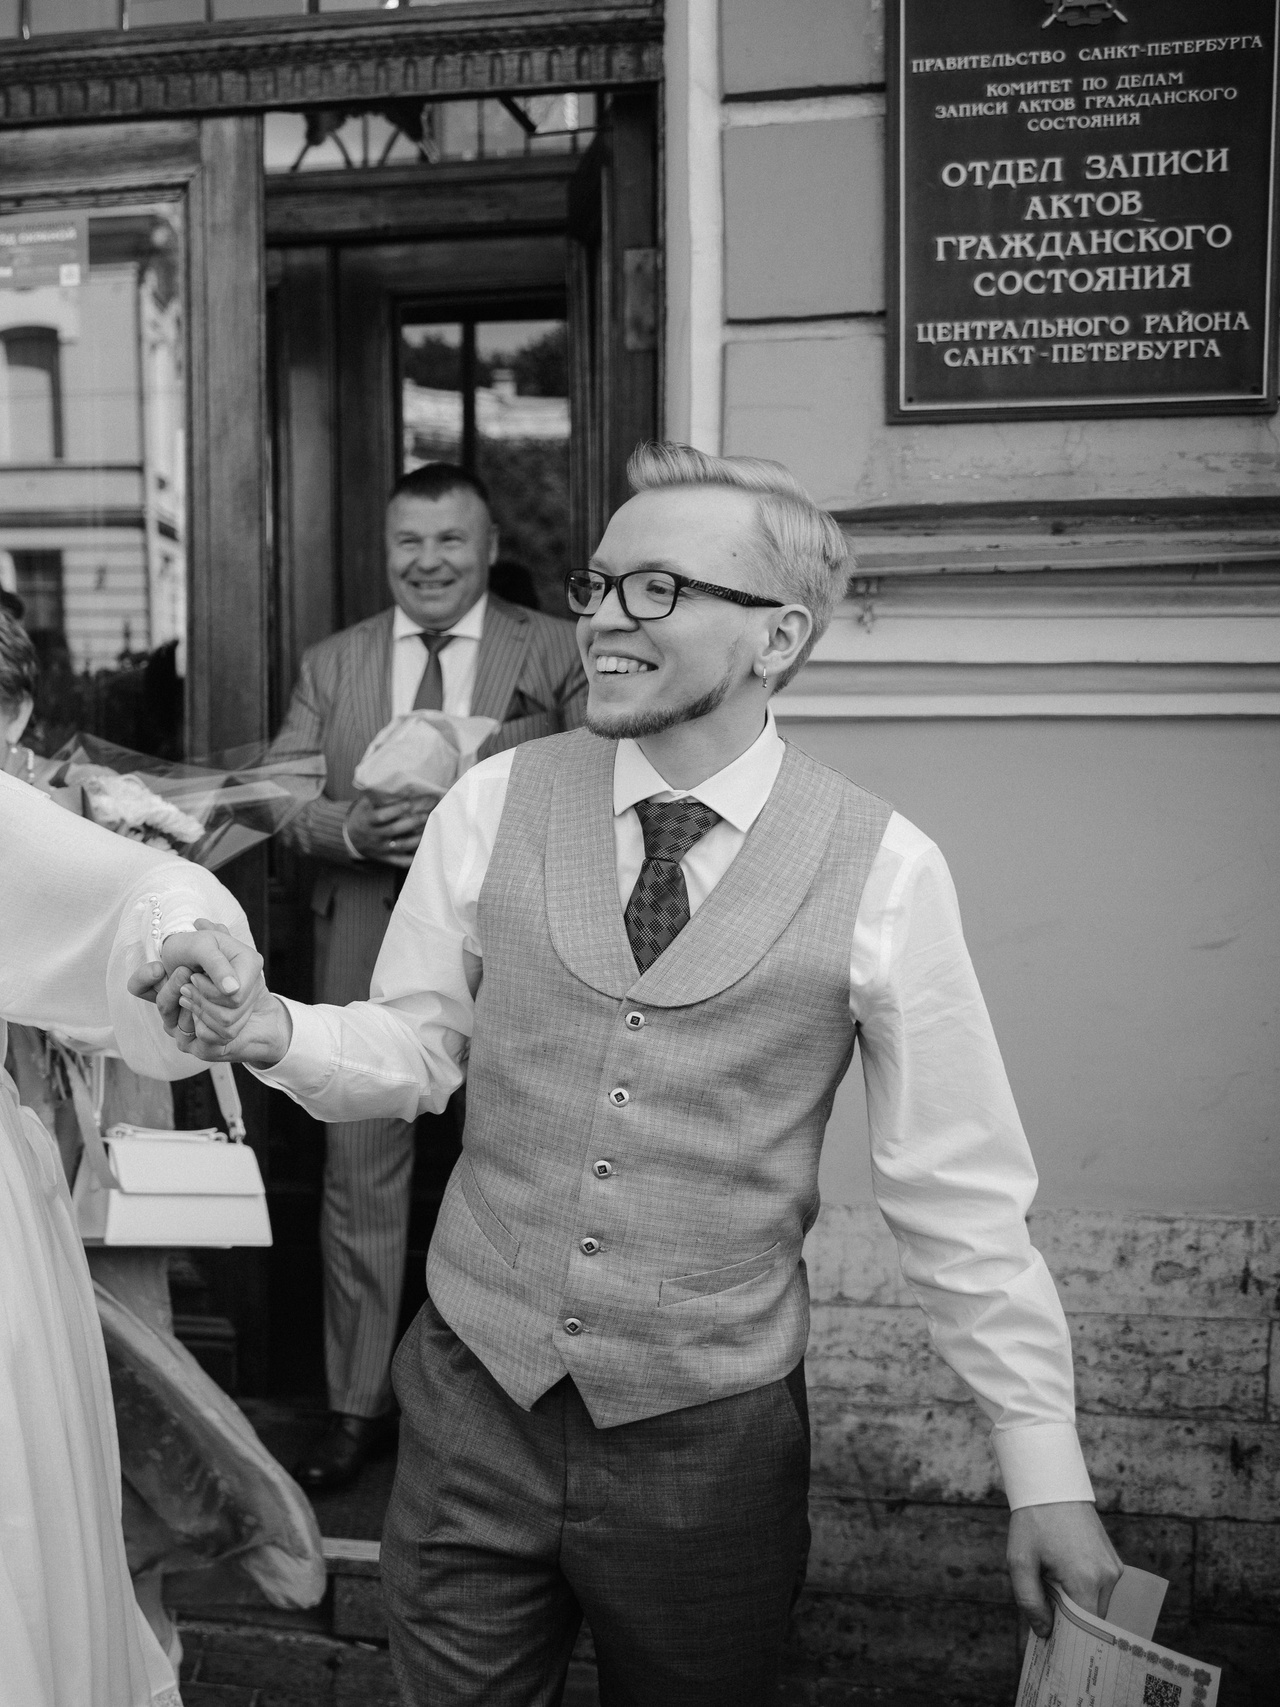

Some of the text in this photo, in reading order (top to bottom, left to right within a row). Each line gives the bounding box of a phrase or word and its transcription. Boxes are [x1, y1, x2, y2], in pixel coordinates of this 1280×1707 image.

[912, 35, 1263, 73] ПРАВИТЕЛЬСТВО САНКТ-ПЕТЕРБУРГА
[987, 72, 1184, 97] КОМИТЕТ ПО ДЕЛАМ
[935, 87, 1238, 119] ЗАПИСИ АКТОВ ГРАЖДАНСКОГО
[1027, 113, 1141, 131] СОСТОЯНИЯ
[941, 148, 1229, 189] ОТДЕЛ ЗАПИСИ
[1024, 191, 1142, 221] АКТОВ
[935, 224, 1232, 262] ГРАЖДАНСКОГО
[973, 263, 1192, 297] СОСТОЯНИЯ
[916, 311, 1250, 345] ЦЕНТРАЛЬНОГО РАЙОНА
[943, 339, 1221, 368] САНКТ-ПЕТЕРБУРГА
